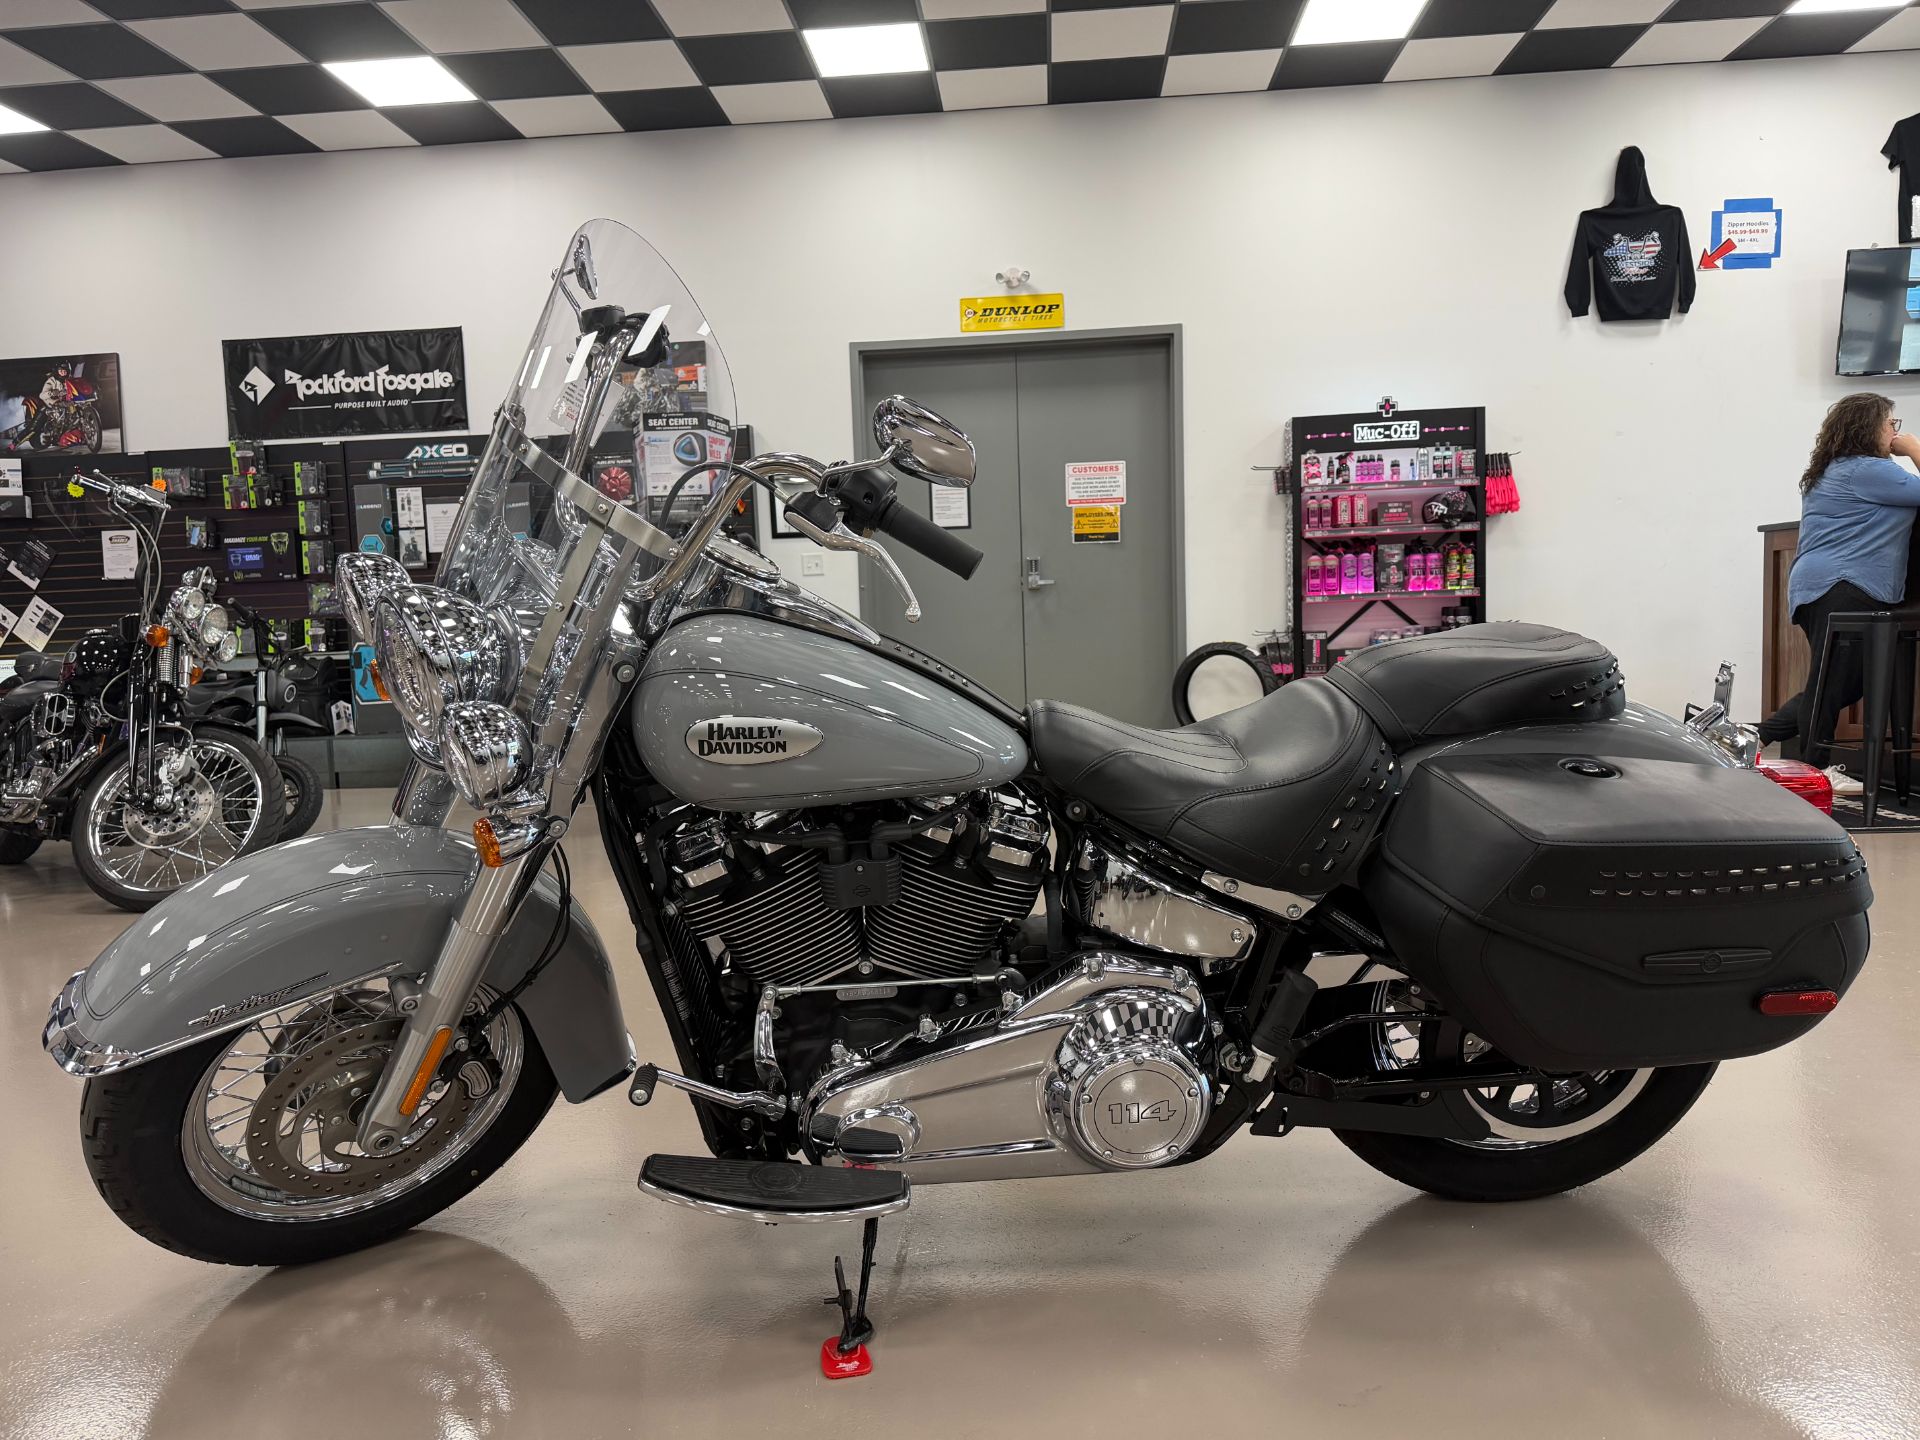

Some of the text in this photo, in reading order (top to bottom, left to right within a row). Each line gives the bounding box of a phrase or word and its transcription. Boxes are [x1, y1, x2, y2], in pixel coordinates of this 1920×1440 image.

[980, 304, 1060, 317] DUNLOP
[978, 313, 1054, 323] MOTORCYCLE TIRES
[284, 363, 454, 402] Rockford Fosgate
[334, 399, 409, 409] PURPOSE BUILT AUDIO
[648, 417, 699, 427] SEAT CENTER
[1357, 423, 1416, 440] Muc-Off
[406, 443, 468, 459] AXEO
[1072, 465, 1120, 474] CUSTOMERS
[698, 739, 787, 756] DAVIDSON
[1108, 1099, 1177, 1125] 114
